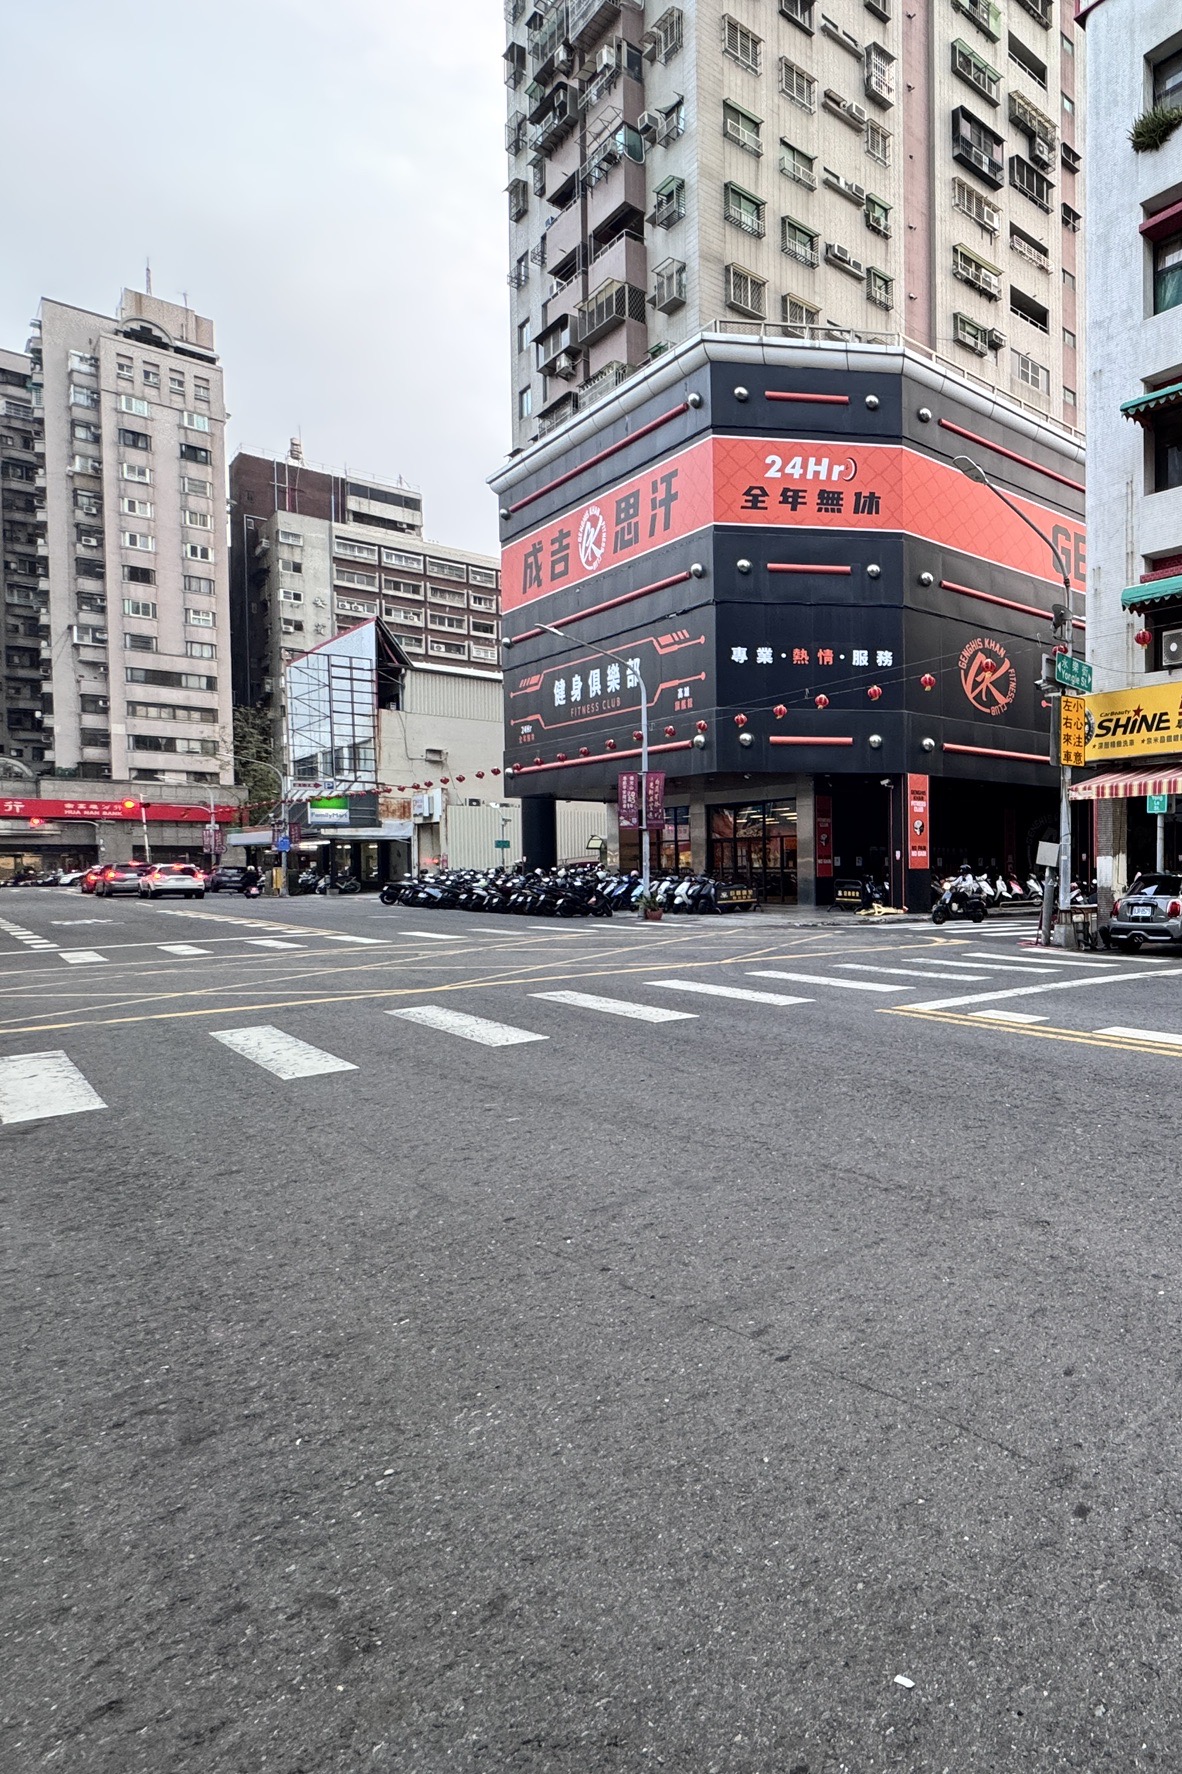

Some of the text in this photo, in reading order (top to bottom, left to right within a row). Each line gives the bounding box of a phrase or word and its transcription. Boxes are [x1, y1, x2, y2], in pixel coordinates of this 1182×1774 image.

[764, 455, 845, 481] 24Hr
[613, 468, 679, 554] 思汗
[740, 485, 881, 515] 全年無休
[958, 638, 1006, 669] GENGHIS KHAN
[1061, 658, 1089, 679] 永樂街
[553, 657, 641, 707] 健身俱樂部
[1008, 668, 1017, 703] FITNESS
[570, 697, 621, 717] FITNESS CLUB
[1062, 699, 1073, 763] 左右來車
[1073, 700, 1083, 765] 小心注意
[310, 811, 348, 819] FamilyMart
